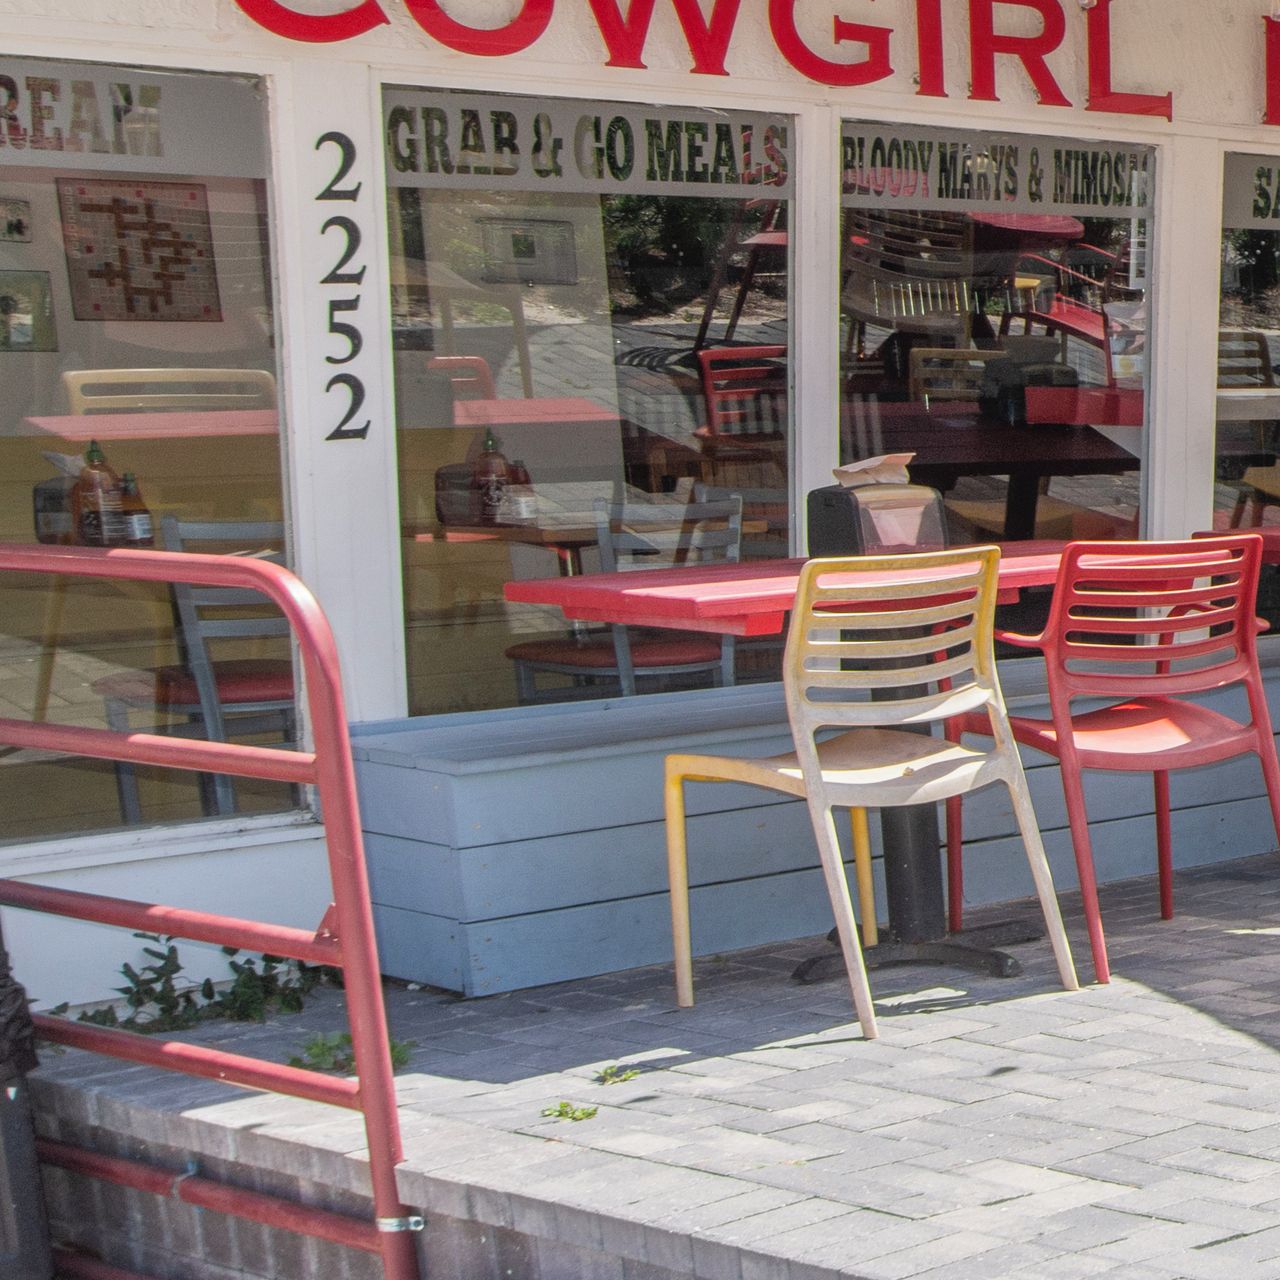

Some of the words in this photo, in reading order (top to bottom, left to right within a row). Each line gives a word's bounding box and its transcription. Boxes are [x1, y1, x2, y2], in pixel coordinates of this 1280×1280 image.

[388, 105, 520, 176] GRAB
[531, 112, 563, 178] &
[574, 115, 636, 181] GO
[645, 118, 788, 187] MEALS
[841, 136, 933, 198] BLOODY
[938, 140, 1018, 203] MARYS
[1028, 147, 1043, 203] &
[314, 130, 371, 442] 2252
